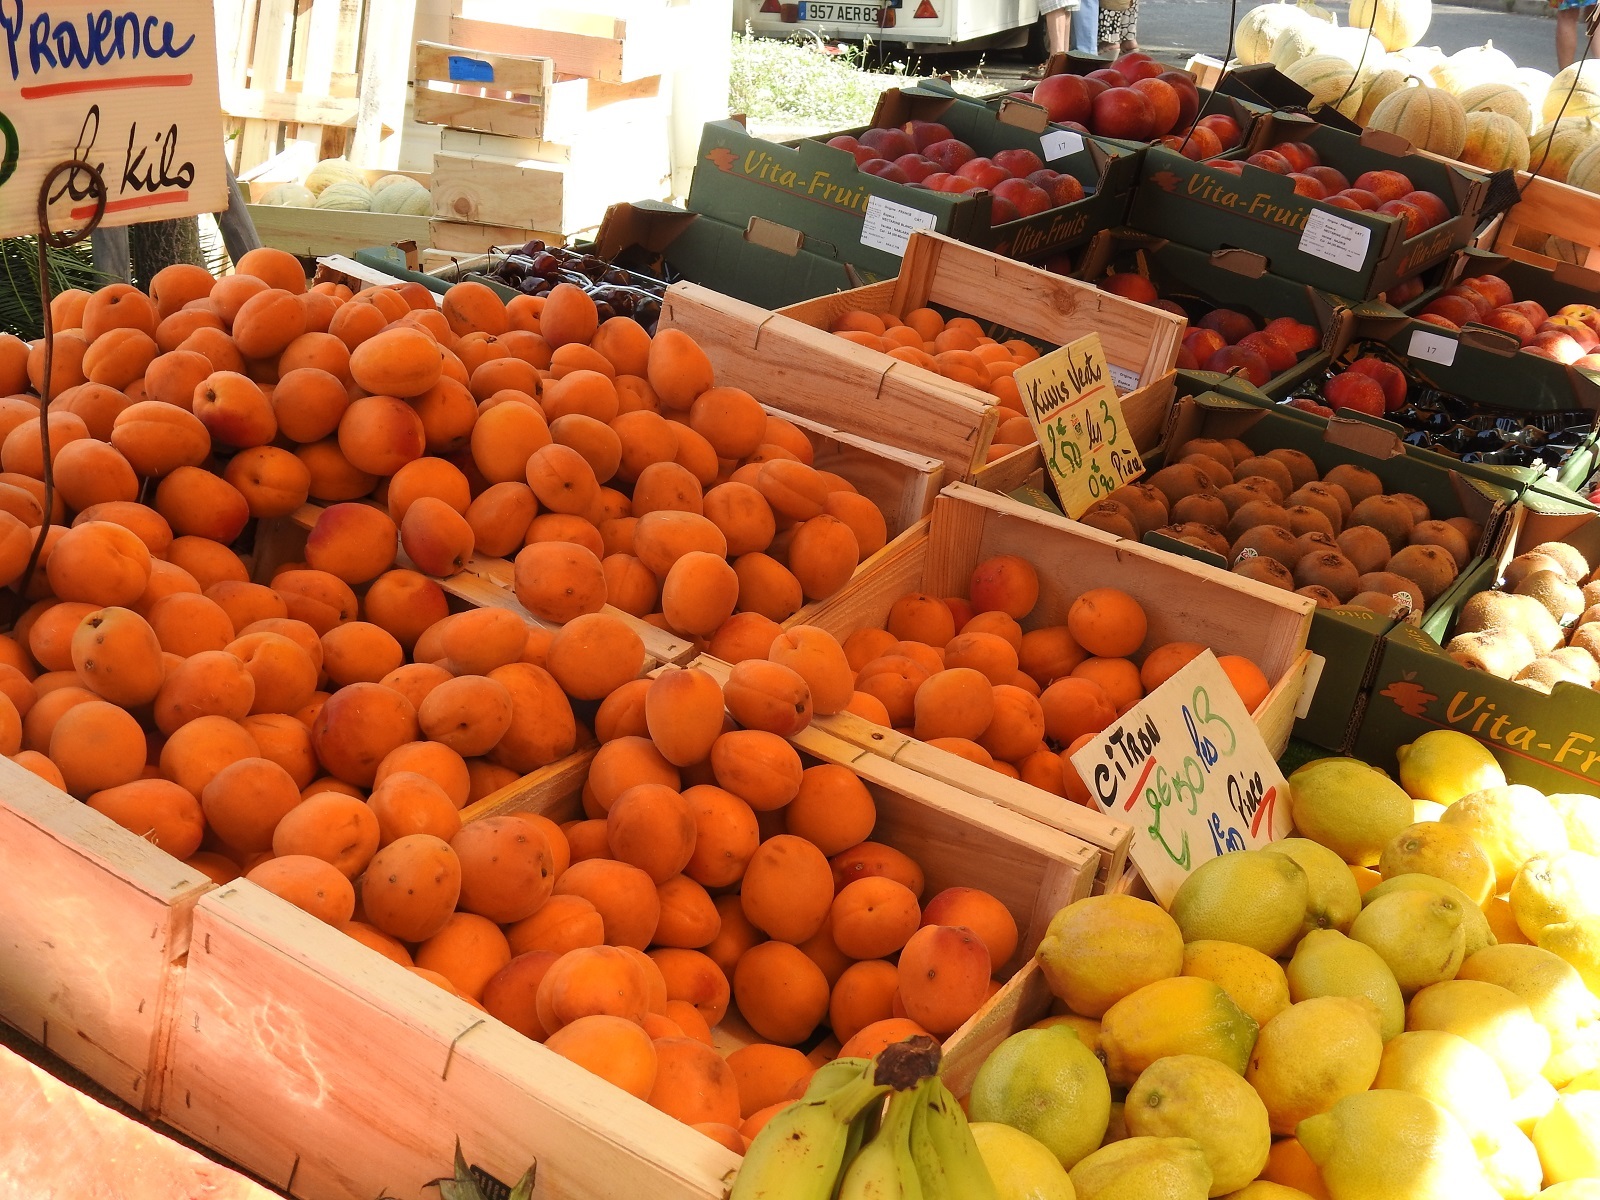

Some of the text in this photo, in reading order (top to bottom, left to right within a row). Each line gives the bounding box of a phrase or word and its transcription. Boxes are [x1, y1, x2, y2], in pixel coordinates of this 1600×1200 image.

[809, 5, 833, 19] 957
[837, 6, 860, 21] AER
[863, 8, 879, 22] 83
[120, 121, 195, 195] kilo
[743, 148, 872, 213] Vita-Fruit
[1186, 172, 1310, 231] Vita-Fruit
[1011, 211, 1089, 257] Vita-Fruits
[1426, 346, 1437, 355] 17
[1026, 370, 1070, 425] Kiwis
[1099, 399, 1118, 446] 3
[1192, 685, 1237, 757] 3
